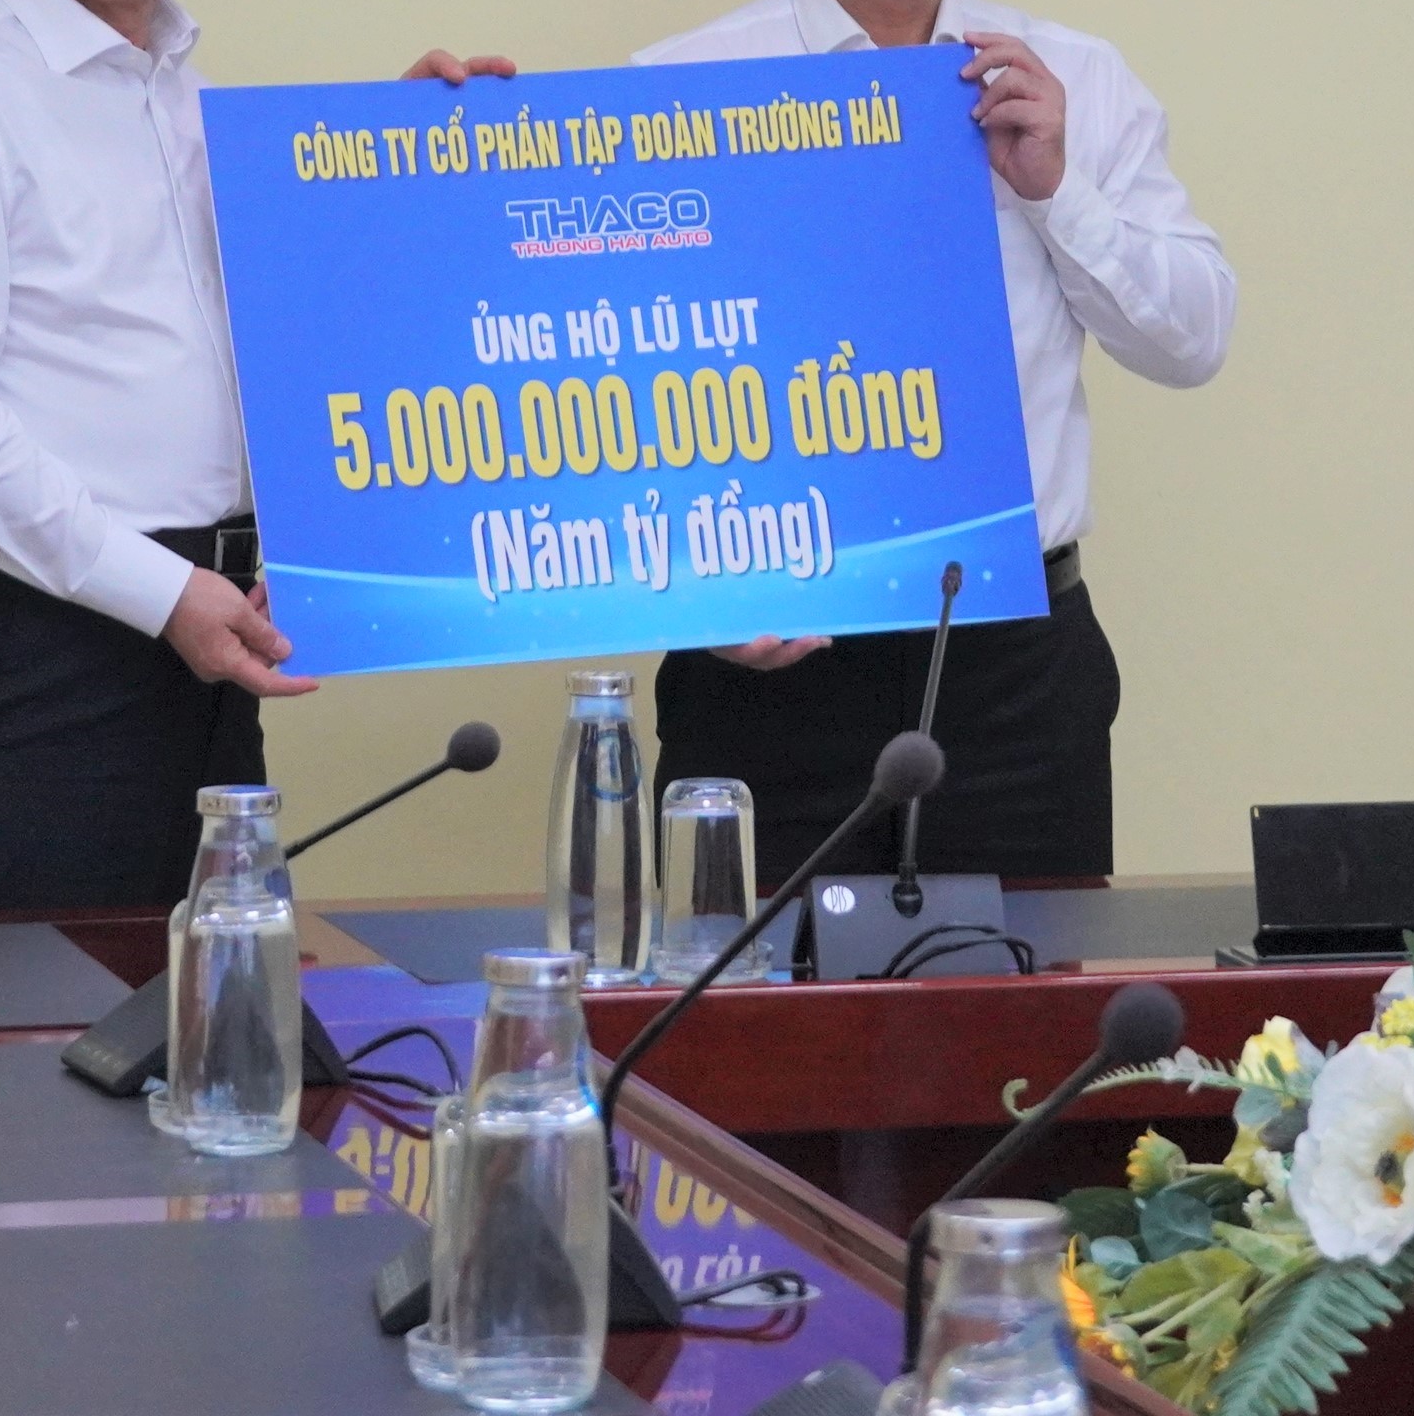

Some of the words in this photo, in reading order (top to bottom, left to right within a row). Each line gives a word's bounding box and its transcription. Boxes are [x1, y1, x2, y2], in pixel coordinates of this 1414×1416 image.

[293, 121, 378, 181] CÔNG
[382, 127, 418, 176] TY
[427, 105, 469, 174] CỔ
[474, 104, 561, 172] PHẦN
[564, 106, 623, 175] TẬP
[630, 100, 716, 162] ĐOÀN
[721, 91, 843, 155] TRƯỜNG
[847, 79, 902, 146] HẢI
[505, 189, 710, 241] THACO
[513, 237, 603, 259] TRUONG
[609, 233, 646, 252] HAI
[651, 230, 713, 250] AUTO
[472, 299, 557, 365] ỦNG
[565, 298, 621, 366] HỘ
[630, 294, 681, 354] LŨ
[689, 297, 758, 358] LỤT
[327, 364, 773, 490] 5.000.000.000
[787, 339, 943, 460] đồng
[471, 503, 613, 603] (Năm
[623, 488, 671, 593] tỷ
[687, 479, 836, 579] đồng)
